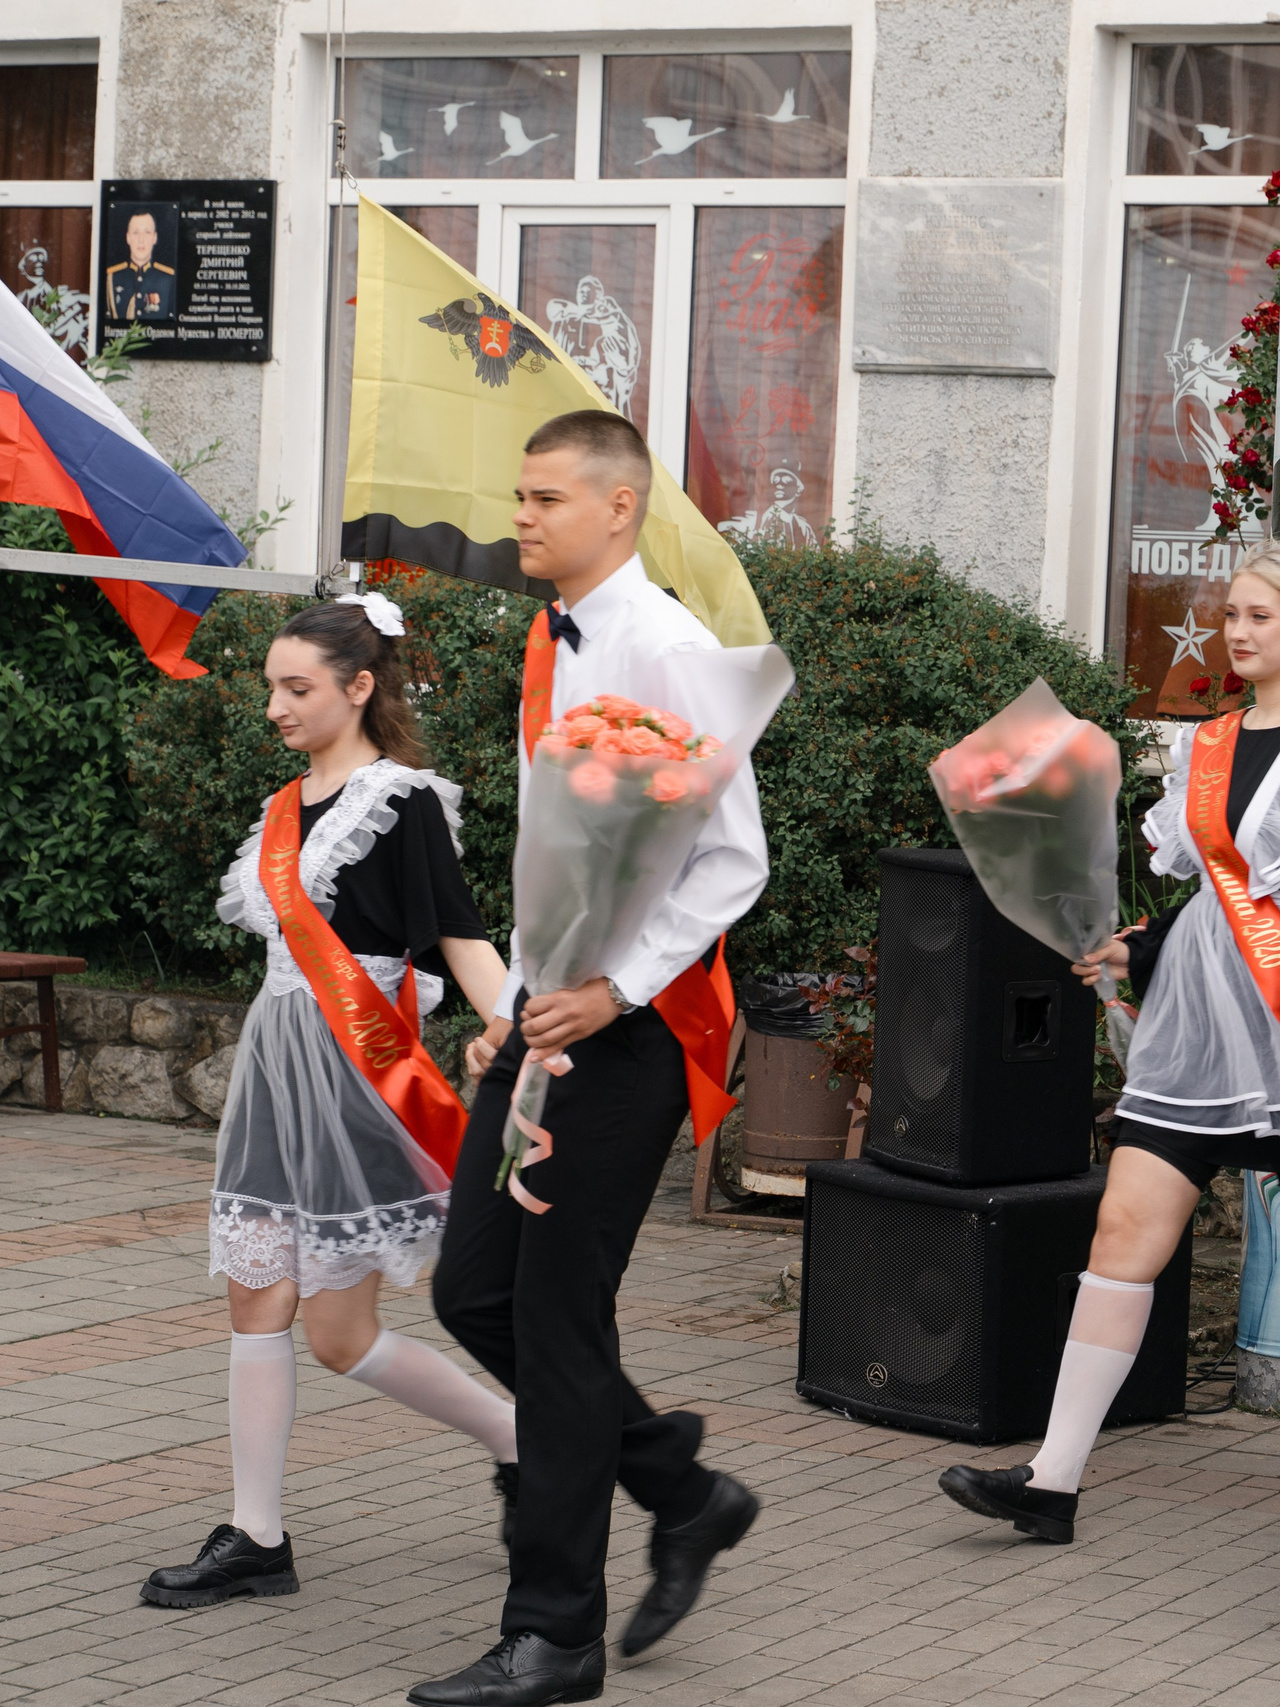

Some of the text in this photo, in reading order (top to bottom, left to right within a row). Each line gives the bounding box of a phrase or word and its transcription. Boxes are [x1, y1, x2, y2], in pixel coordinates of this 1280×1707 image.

[196, 244, 251, 256] ТЕРЕЩЕНКО
[200, 256, 245, 268] ДМИТРИЙ
[196, 269, 248, 280] СЕРГЕЕВИЧ
[217, 327, 264, 340] ПОСМЕРТНО
[329, 946, 359, 981] Кира
[347, 1010, 411, 1069] 2026
